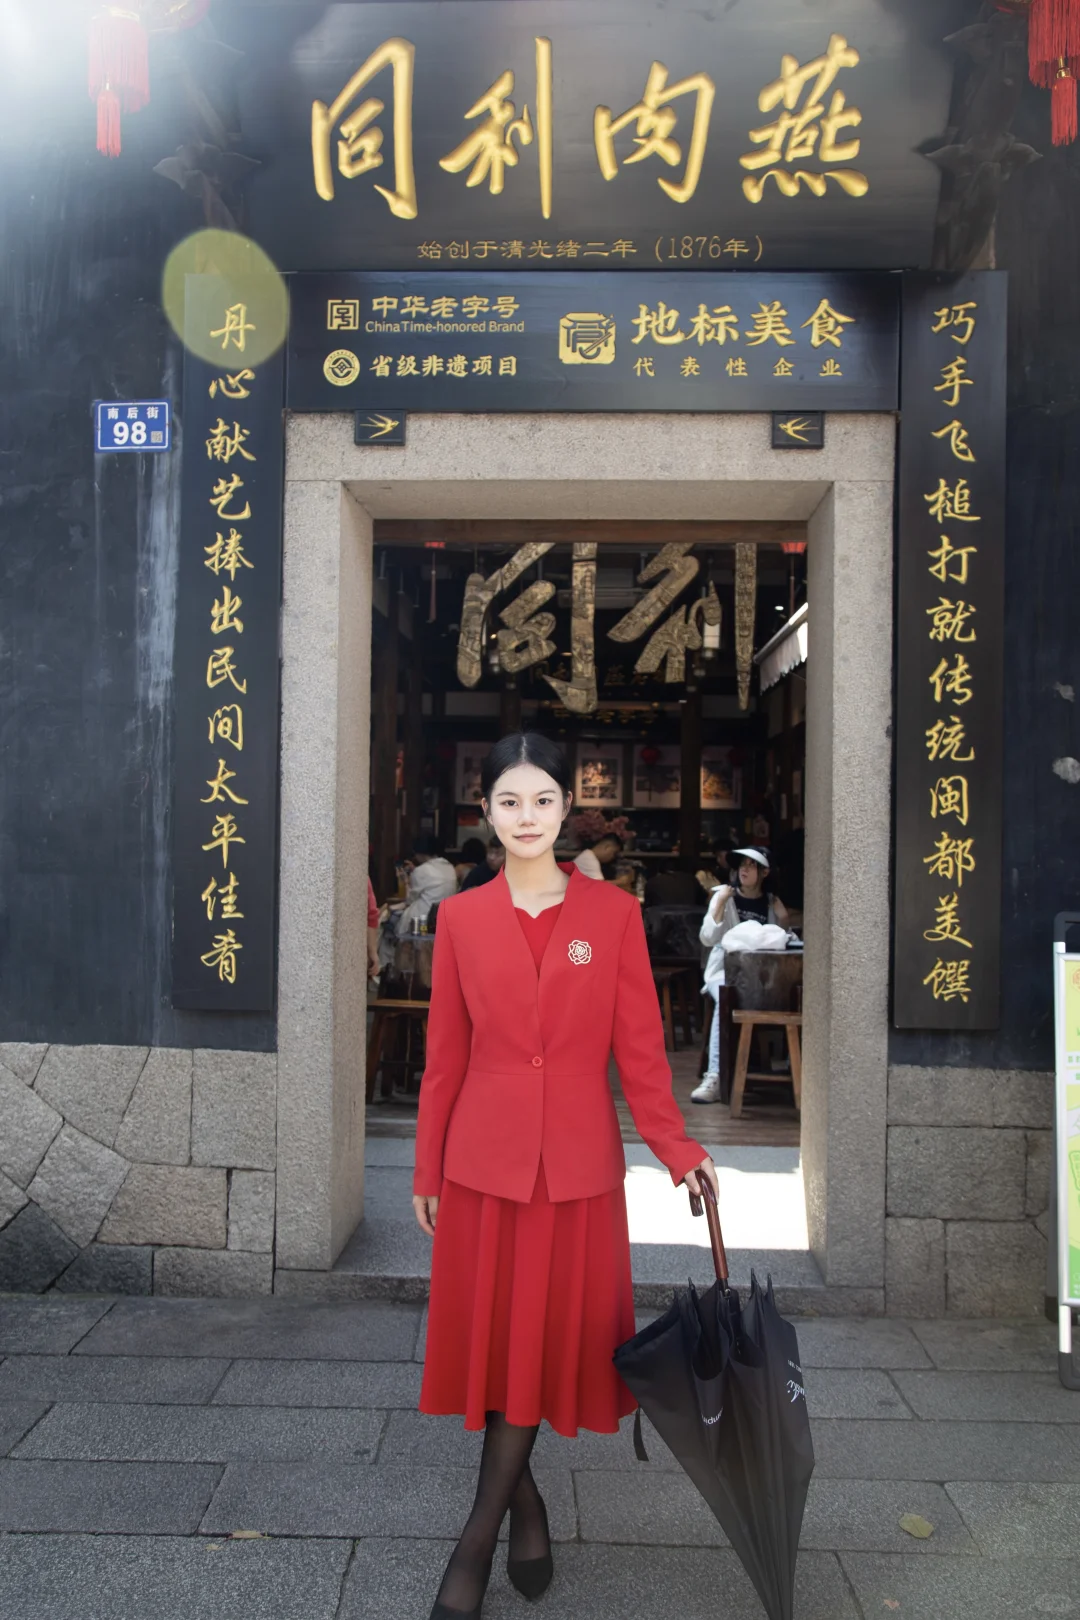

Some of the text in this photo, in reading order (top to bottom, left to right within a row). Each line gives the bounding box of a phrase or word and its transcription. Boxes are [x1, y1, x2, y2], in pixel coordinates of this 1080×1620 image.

[311, 33, 869, 219] 同利肉燕
[371, 295, 521, 319] 中华老字号
[365, 320, 525, 333] China Time-honored Brand
[630, 298, 856, 349] 地标美食
[368, 354, 518, 378] 省级非遗项目
[632, 355, 844, 378] 代表性企业
[107, 406, 159, 420] 南后街
[113, 421, 147, 446] 98
